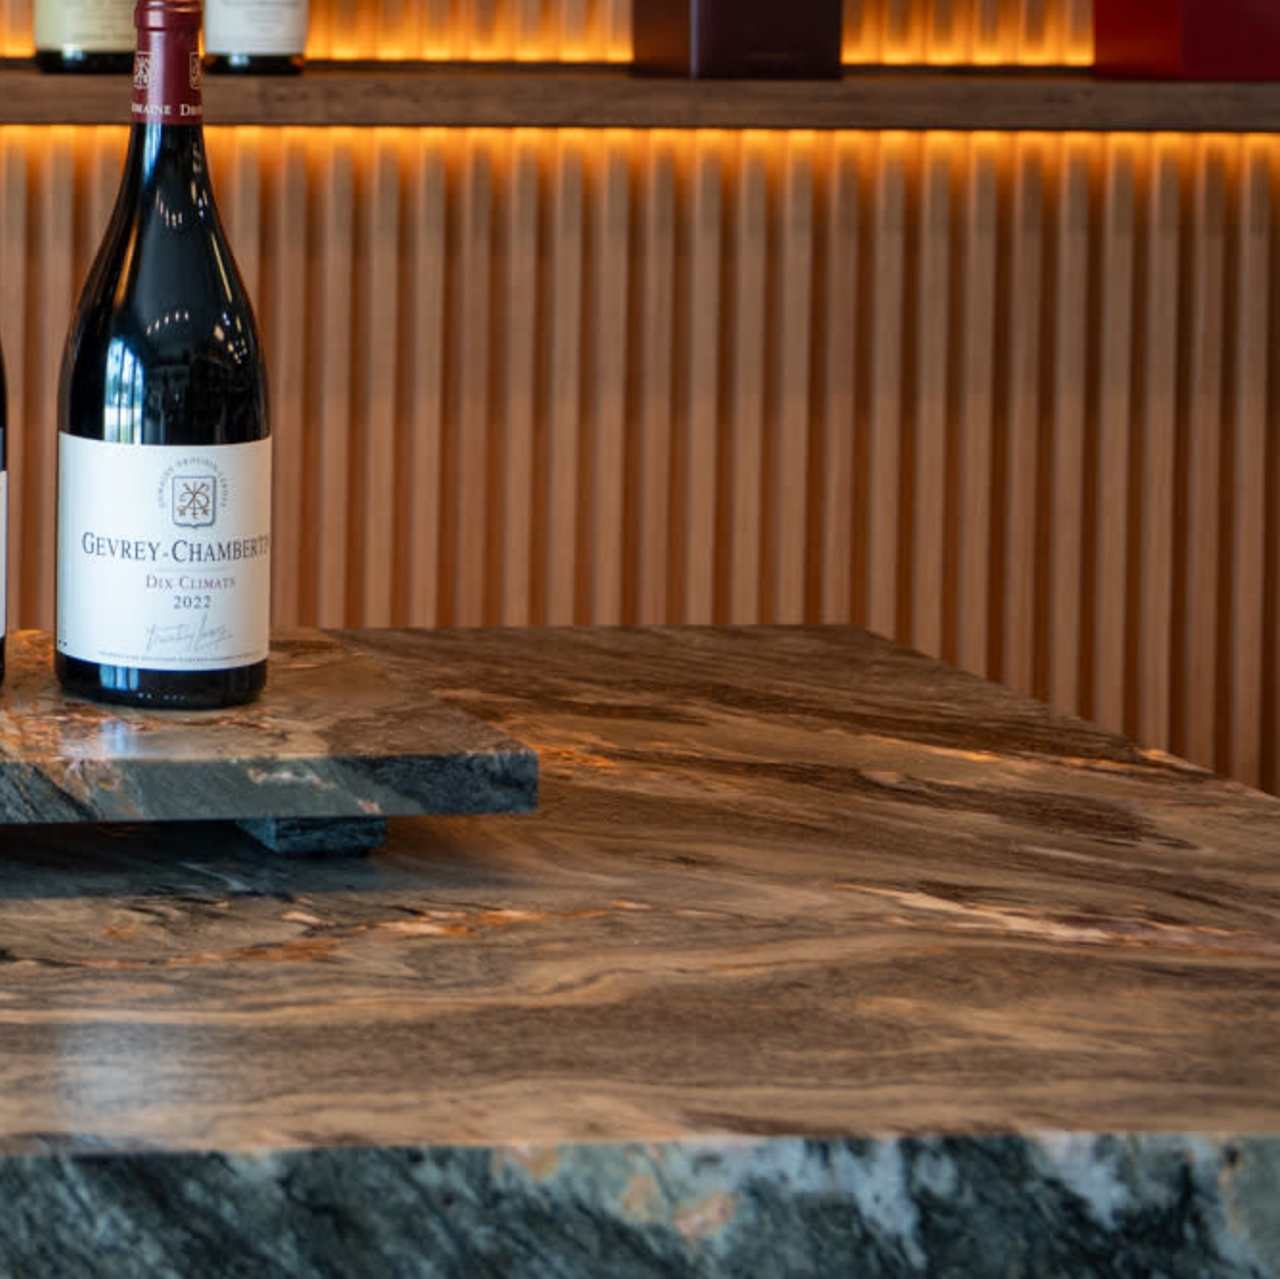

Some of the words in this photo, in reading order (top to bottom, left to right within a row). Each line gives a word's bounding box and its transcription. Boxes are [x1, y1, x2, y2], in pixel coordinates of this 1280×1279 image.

[145, 575, 174, 589] DIX
[178, 575, 237, 590] CLIMATS
[173, 595, 212, 609] 2022
